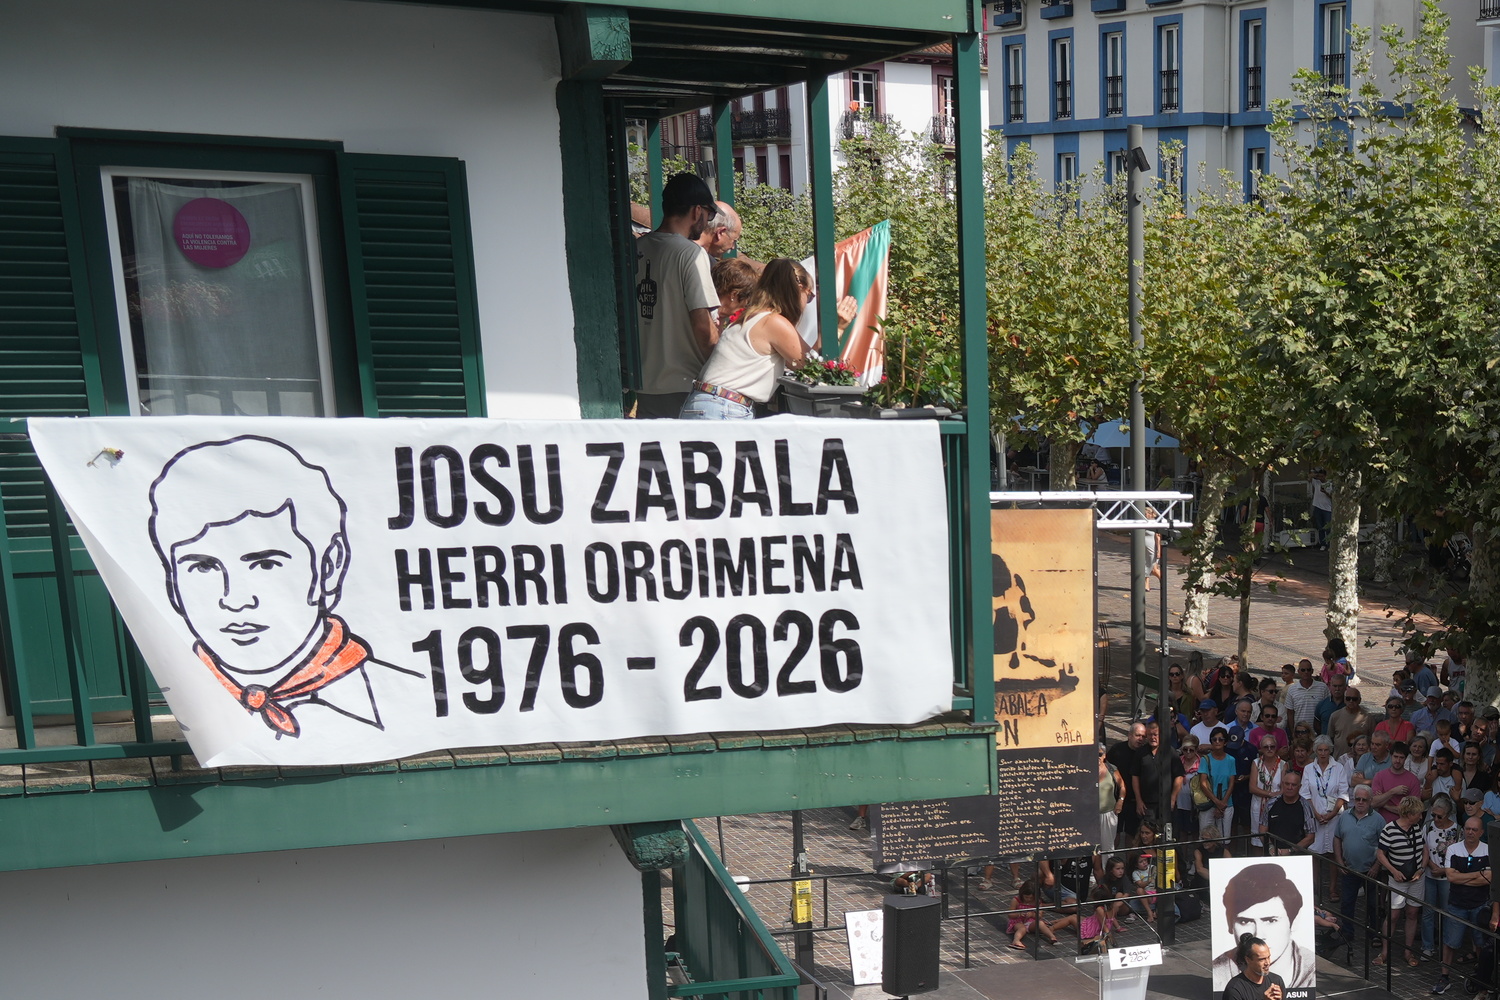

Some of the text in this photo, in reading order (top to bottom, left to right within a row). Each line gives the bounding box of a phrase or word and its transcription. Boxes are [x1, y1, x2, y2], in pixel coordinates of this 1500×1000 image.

[388, 439, 858, 529] JOSU ZABALA
[396, 534, 862, 611] HERRI OROIMENA
[411, 623, 603, 717] 1976
[680, 609, 862, 701] 2026
[994, 692, 1048, 716] ABALA
[1055, 730, 1082, 743] BALA
